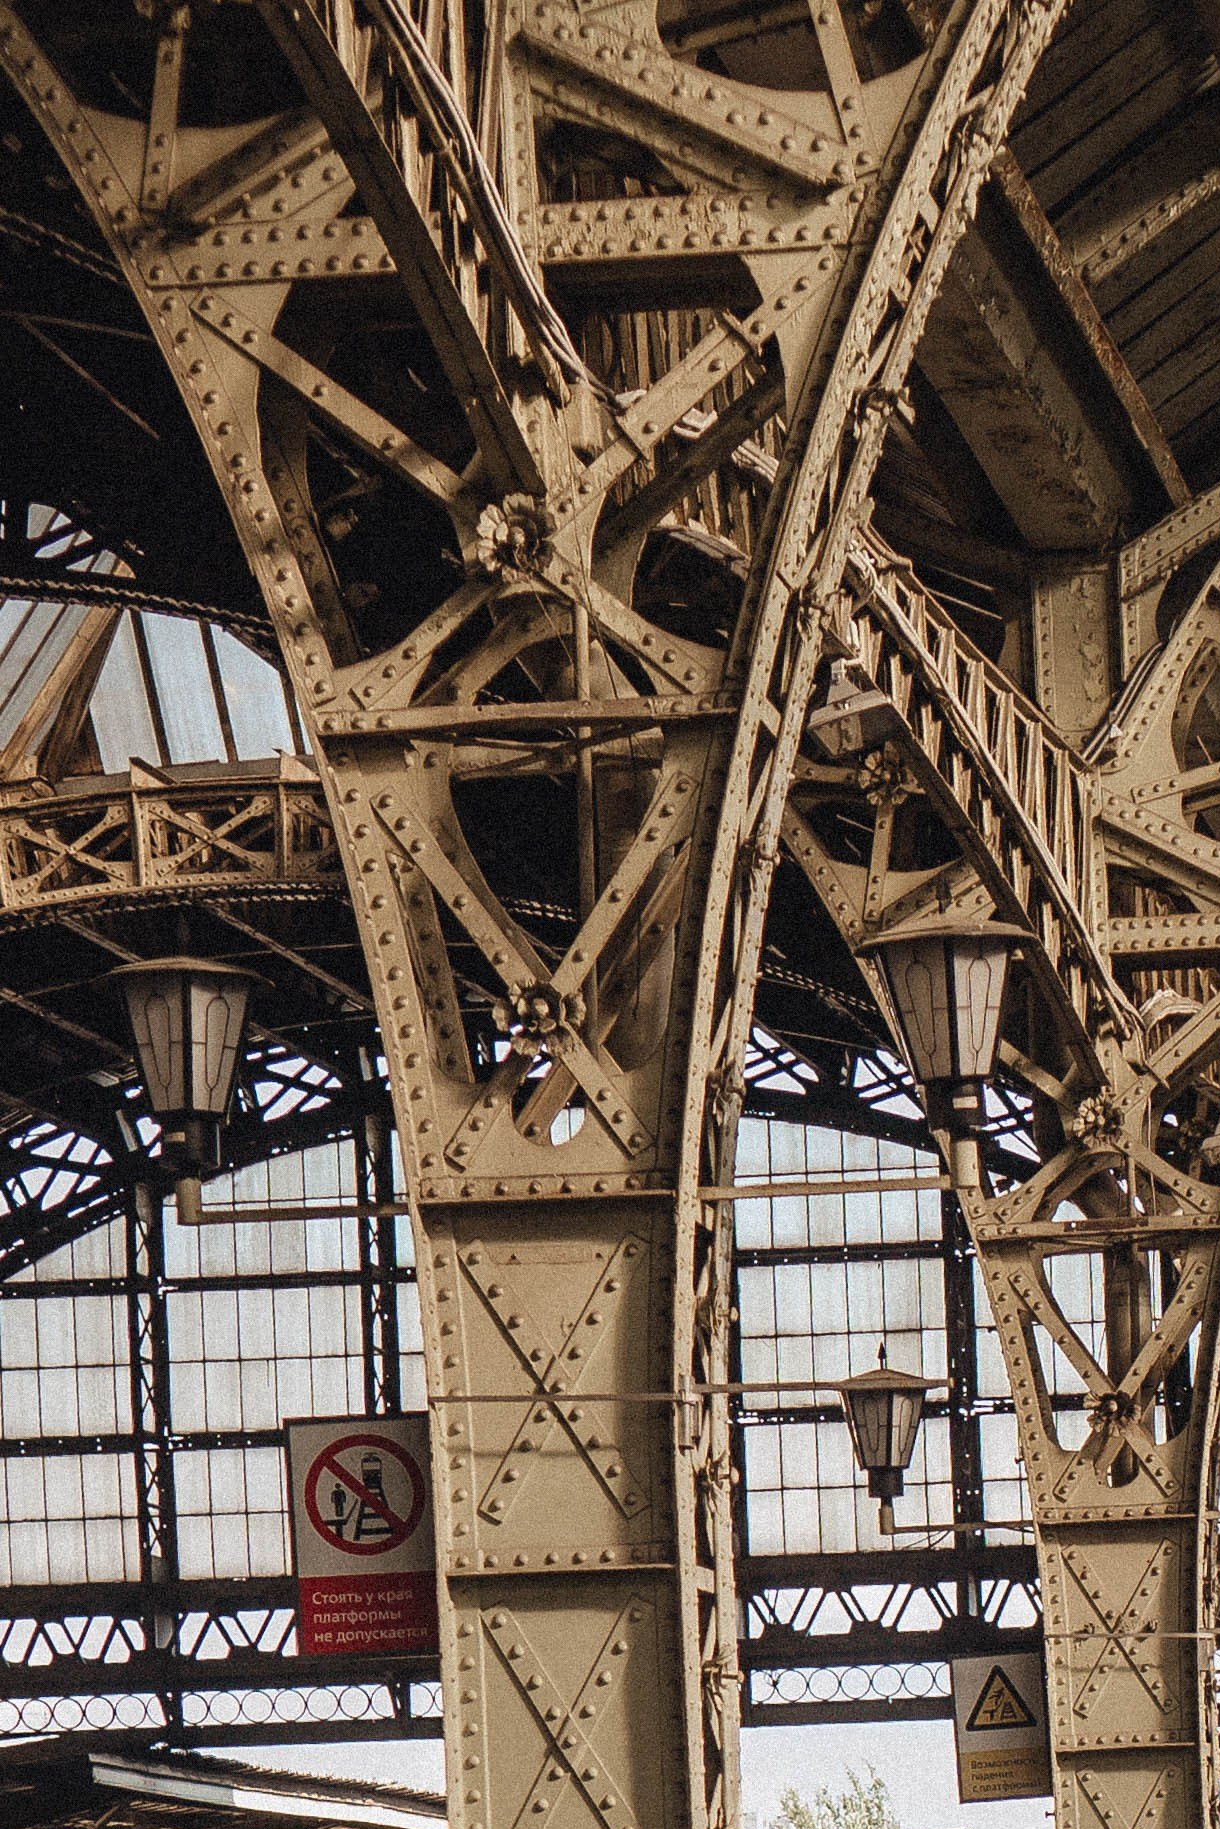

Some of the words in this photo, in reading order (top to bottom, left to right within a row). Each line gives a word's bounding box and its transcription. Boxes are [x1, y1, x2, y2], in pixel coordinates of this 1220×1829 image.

[312, 1591, 362, 1604] Стоять
[365, 1592, 374, 1606] у
[378, 1590, 413, 1603] края
[313, 1610, 401, 1624] платформы
[314, 1631, 333, 1643] не
[336, 1627, 428, 1643] допускается
